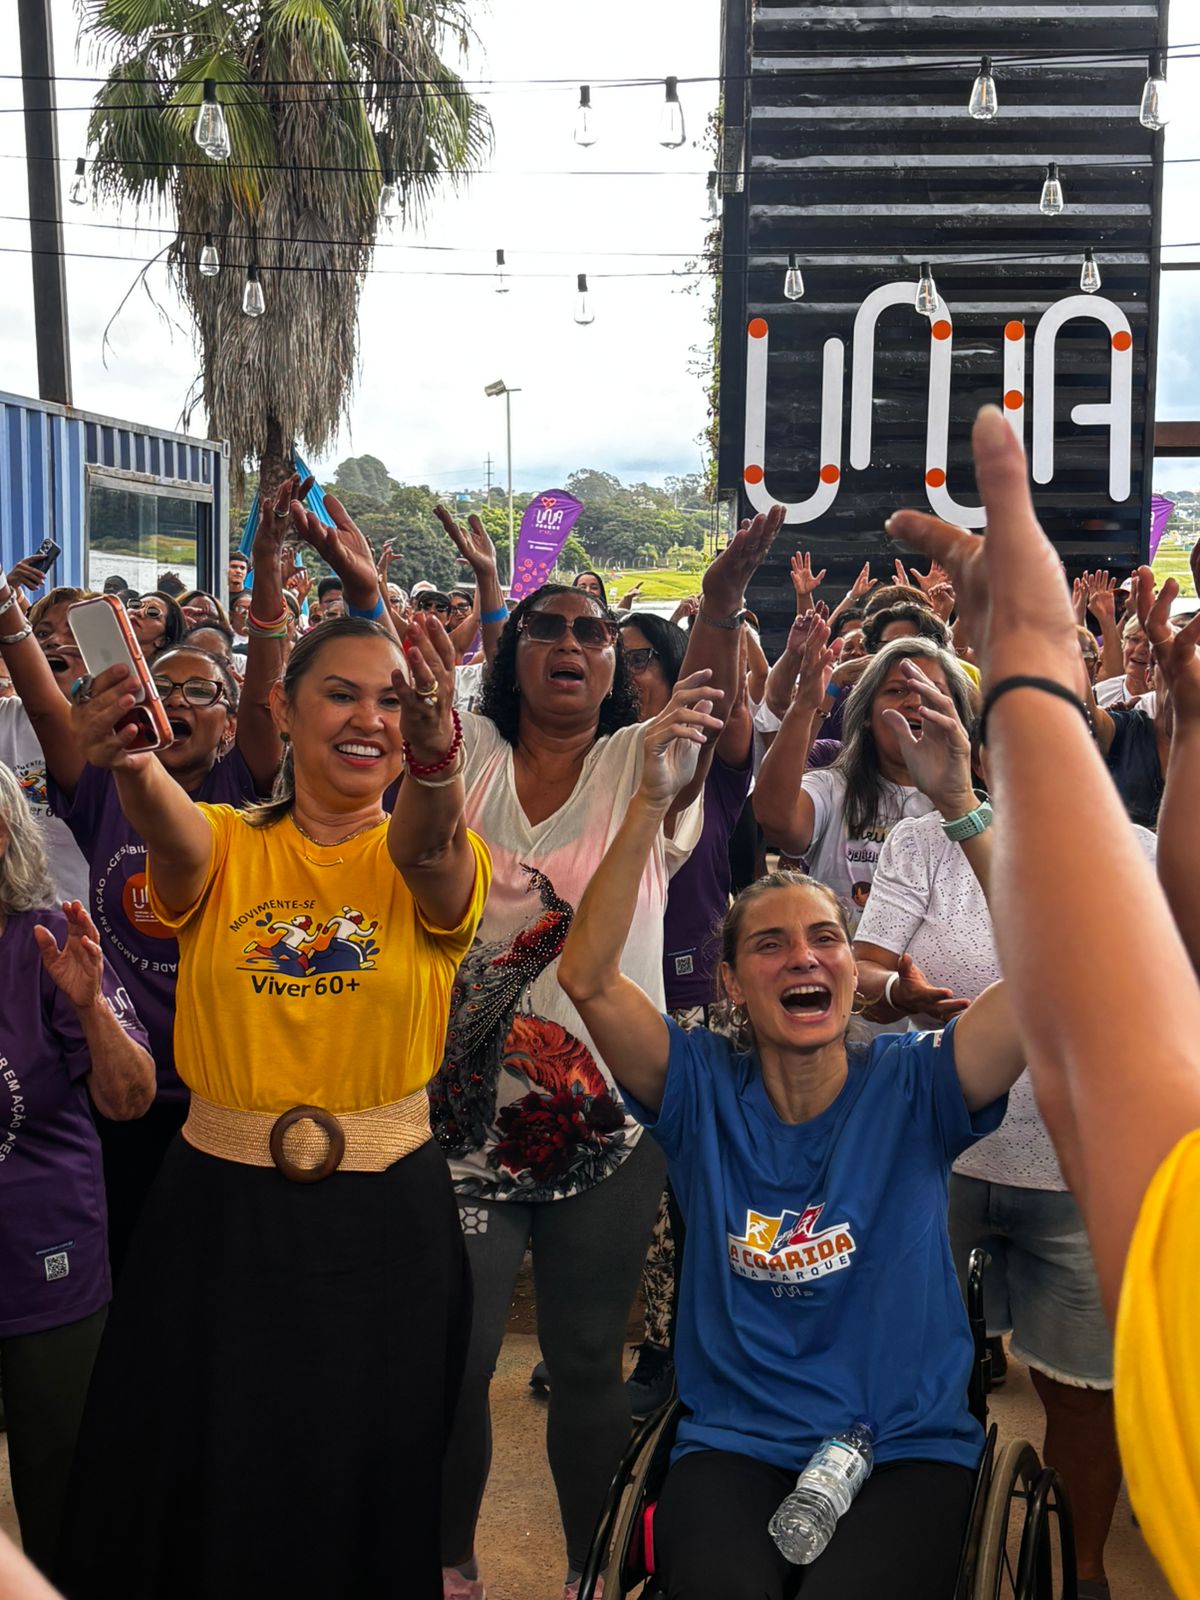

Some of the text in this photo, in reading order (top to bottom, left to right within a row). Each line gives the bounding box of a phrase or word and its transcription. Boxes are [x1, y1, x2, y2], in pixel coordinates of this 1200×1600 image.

[229, 899, 316, 932] MOVIMENTE-SE
[251, 975, 360, 998] Viver 60+
[3, 1069, 20, 1092] EM
[10, 1095, 26, 1129] AÇÃO
[742, 1232, 854, 1272] CORRIDA
[769, 1255, 848, 1281] PARQUE
